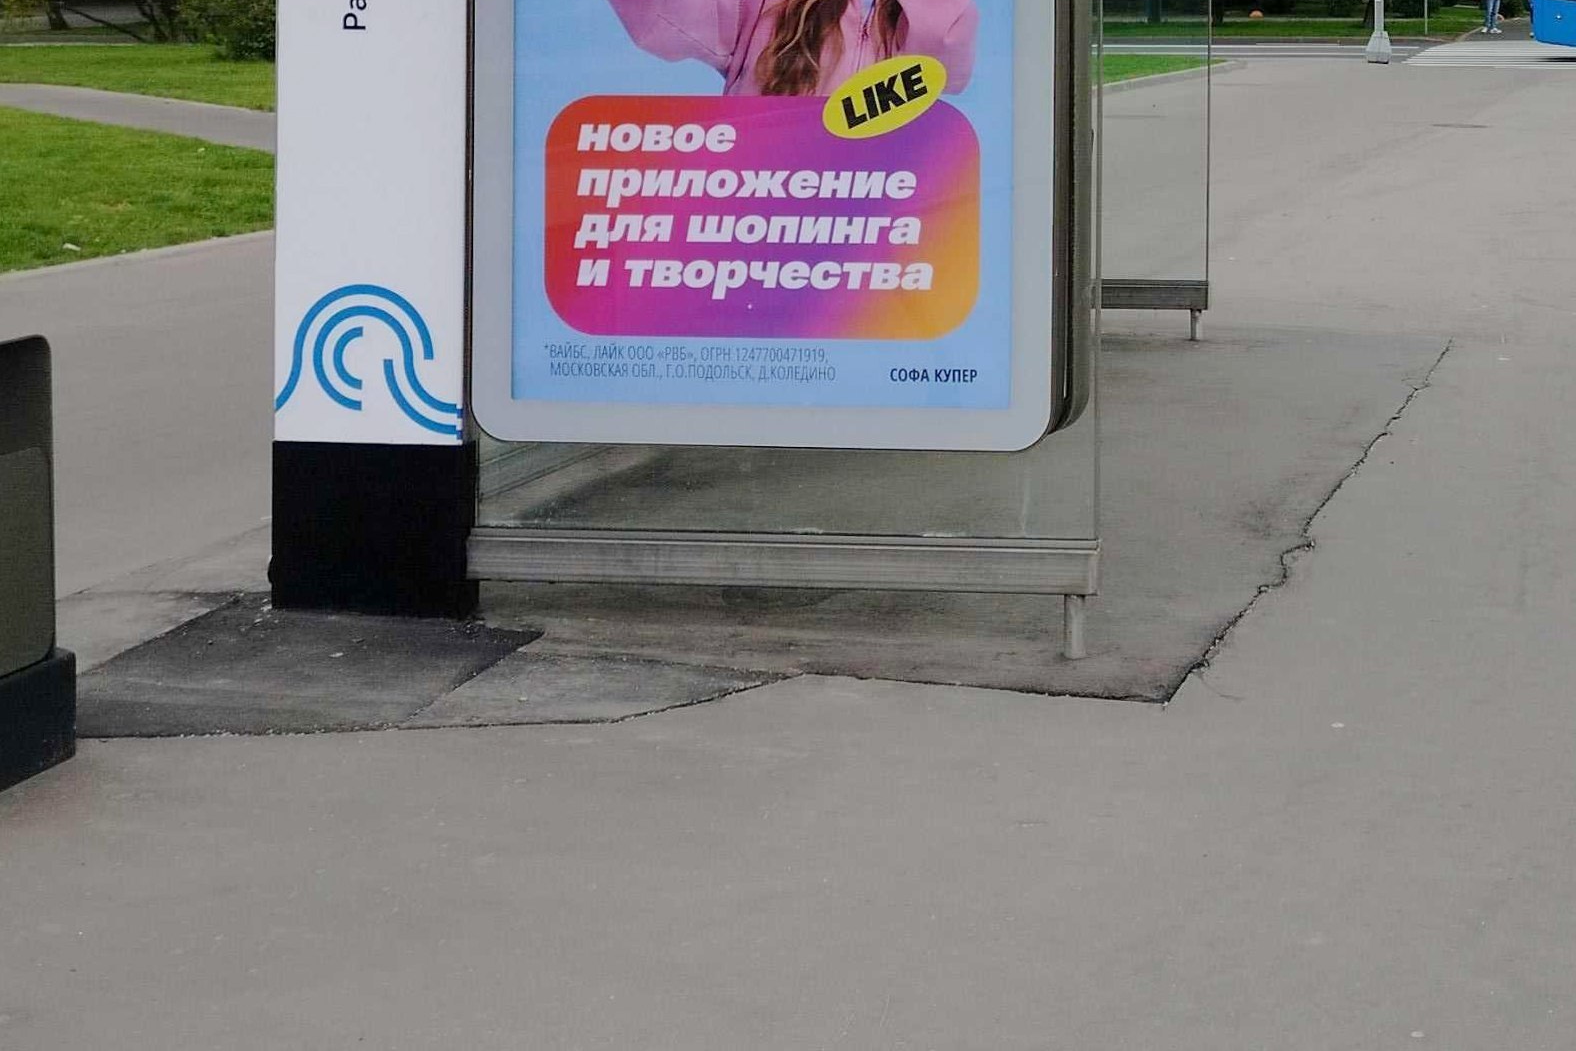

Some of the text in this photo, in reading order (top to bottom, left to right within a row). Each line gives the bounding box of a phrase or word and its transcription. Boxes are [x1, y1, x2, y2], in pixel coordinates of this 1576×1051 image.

[841, 64, 928, 129] LIKE
[577, 123, 737, 153] новое
[576, 169, 918, 208] приложение
[574, 213, 922, 249] для шопинга
[576, 258, 935, 301] и творчества
[550, 361, 629, 377] МОСКОВСКАЯ
[594, 343, 625, 360] ЛАЙК
[627, 345, 654, 361] ООО
[700, 346, 731, 362] ОГРН
[890, 368, 978, 383] СОФА КУПЕР
